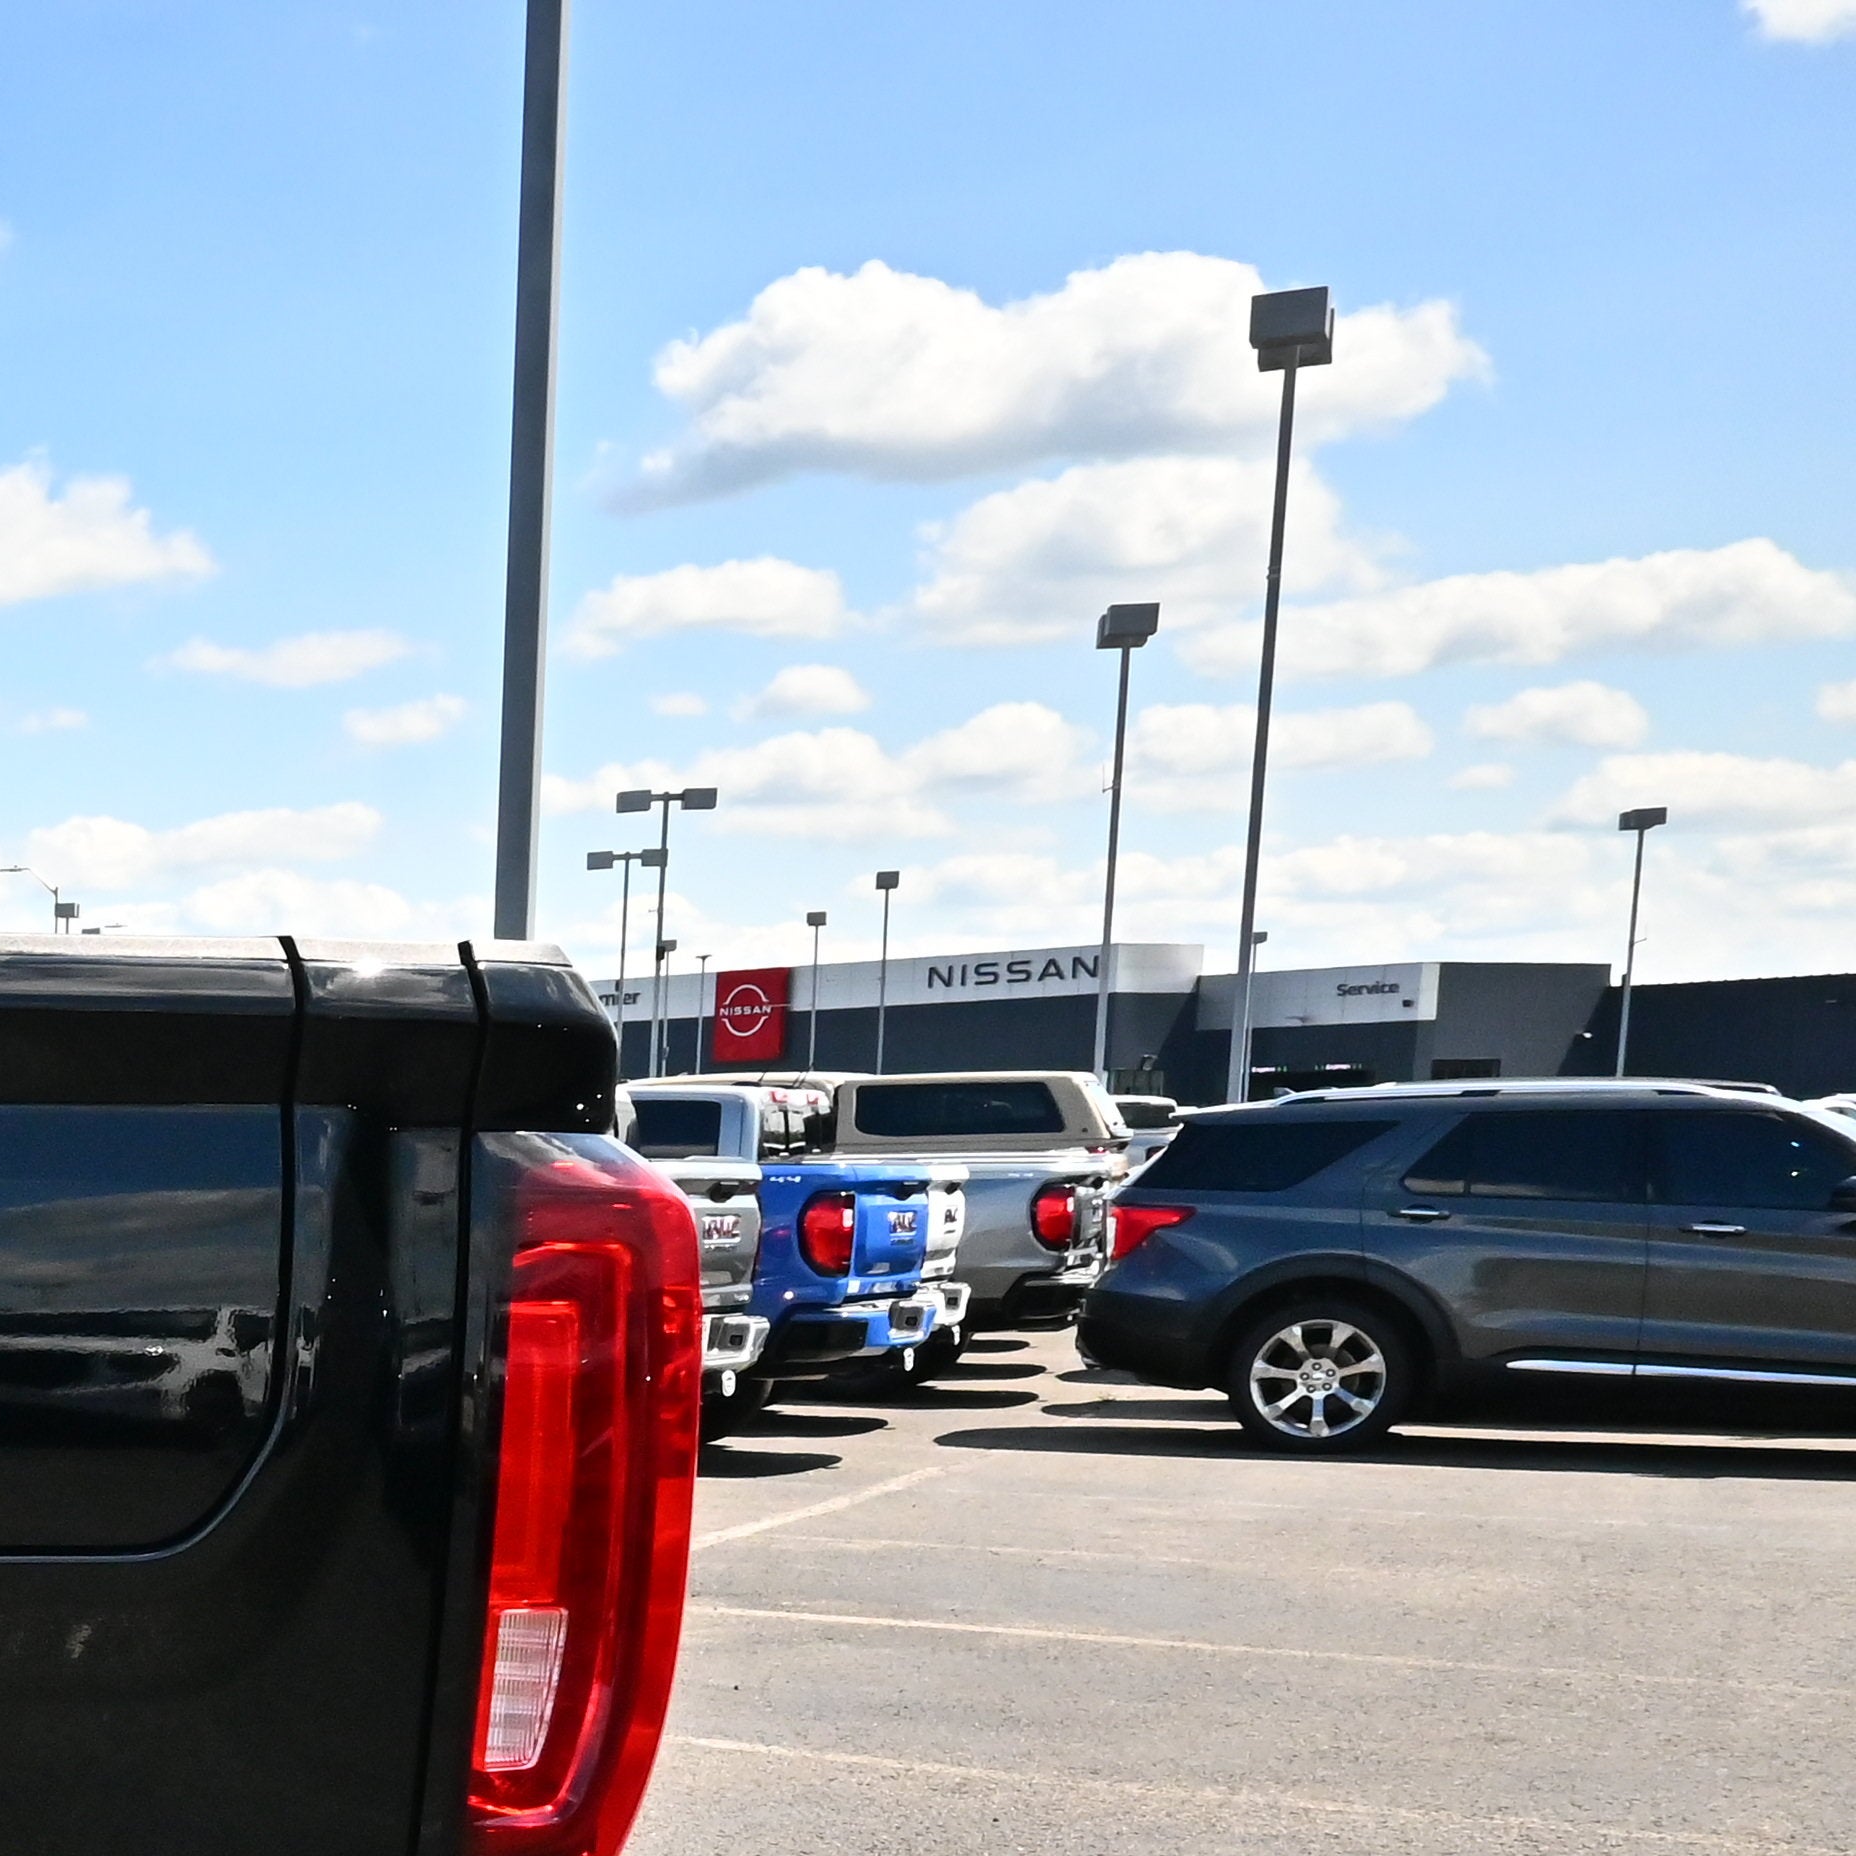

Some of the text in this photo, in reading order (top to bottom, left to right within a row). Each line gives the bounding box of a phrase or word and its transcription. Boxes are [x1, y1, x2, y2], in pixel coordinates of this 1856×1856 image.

[927, 955, 1100, 988] NISSAN
[1336, 981, 1400, 997] Service
[598, 991, 642, 1007] mier
[719, 1006, 772, 1017] NISSAN
